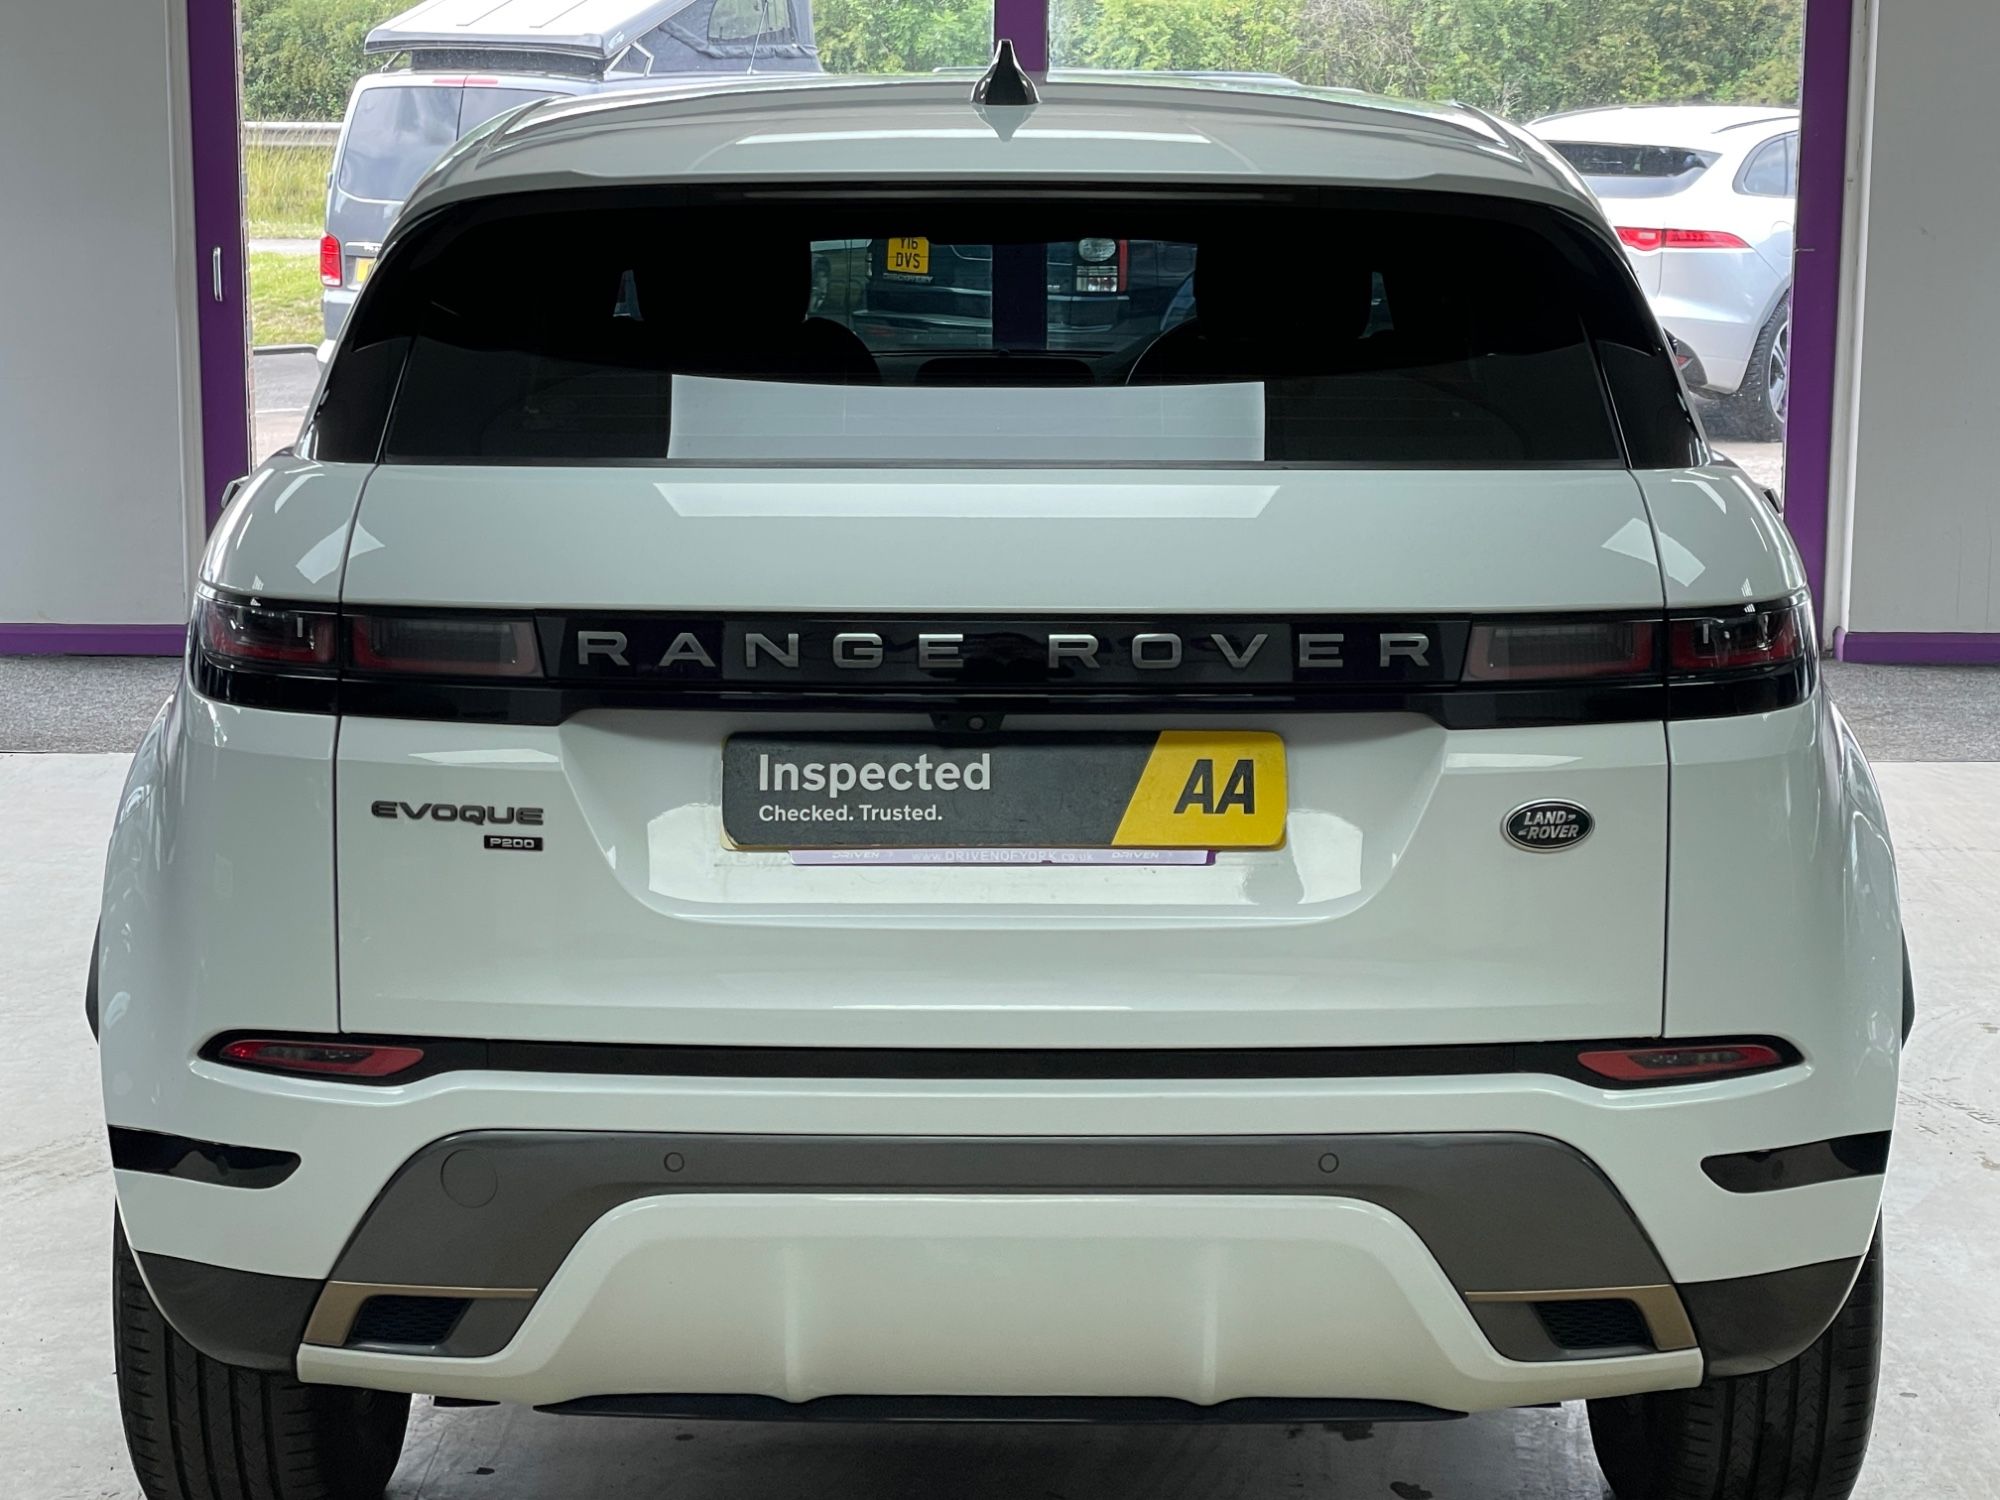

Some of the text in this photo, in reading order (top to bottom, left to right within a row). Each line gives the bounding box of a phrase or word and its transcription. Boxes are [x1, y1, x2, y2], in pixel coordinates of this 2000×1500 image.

[896, 252, 921, 269] DVS
[577, 631, 1431, 669] RANGE ROVER
[759, 753, 991, 797] Inspected
[1173, 759, 1256, 814] AA
[371, 800, 544, 826] EVOQUE
[758, 804, 943, 822] Checked. Trusted.
[489, 838, 535, 849] P200
